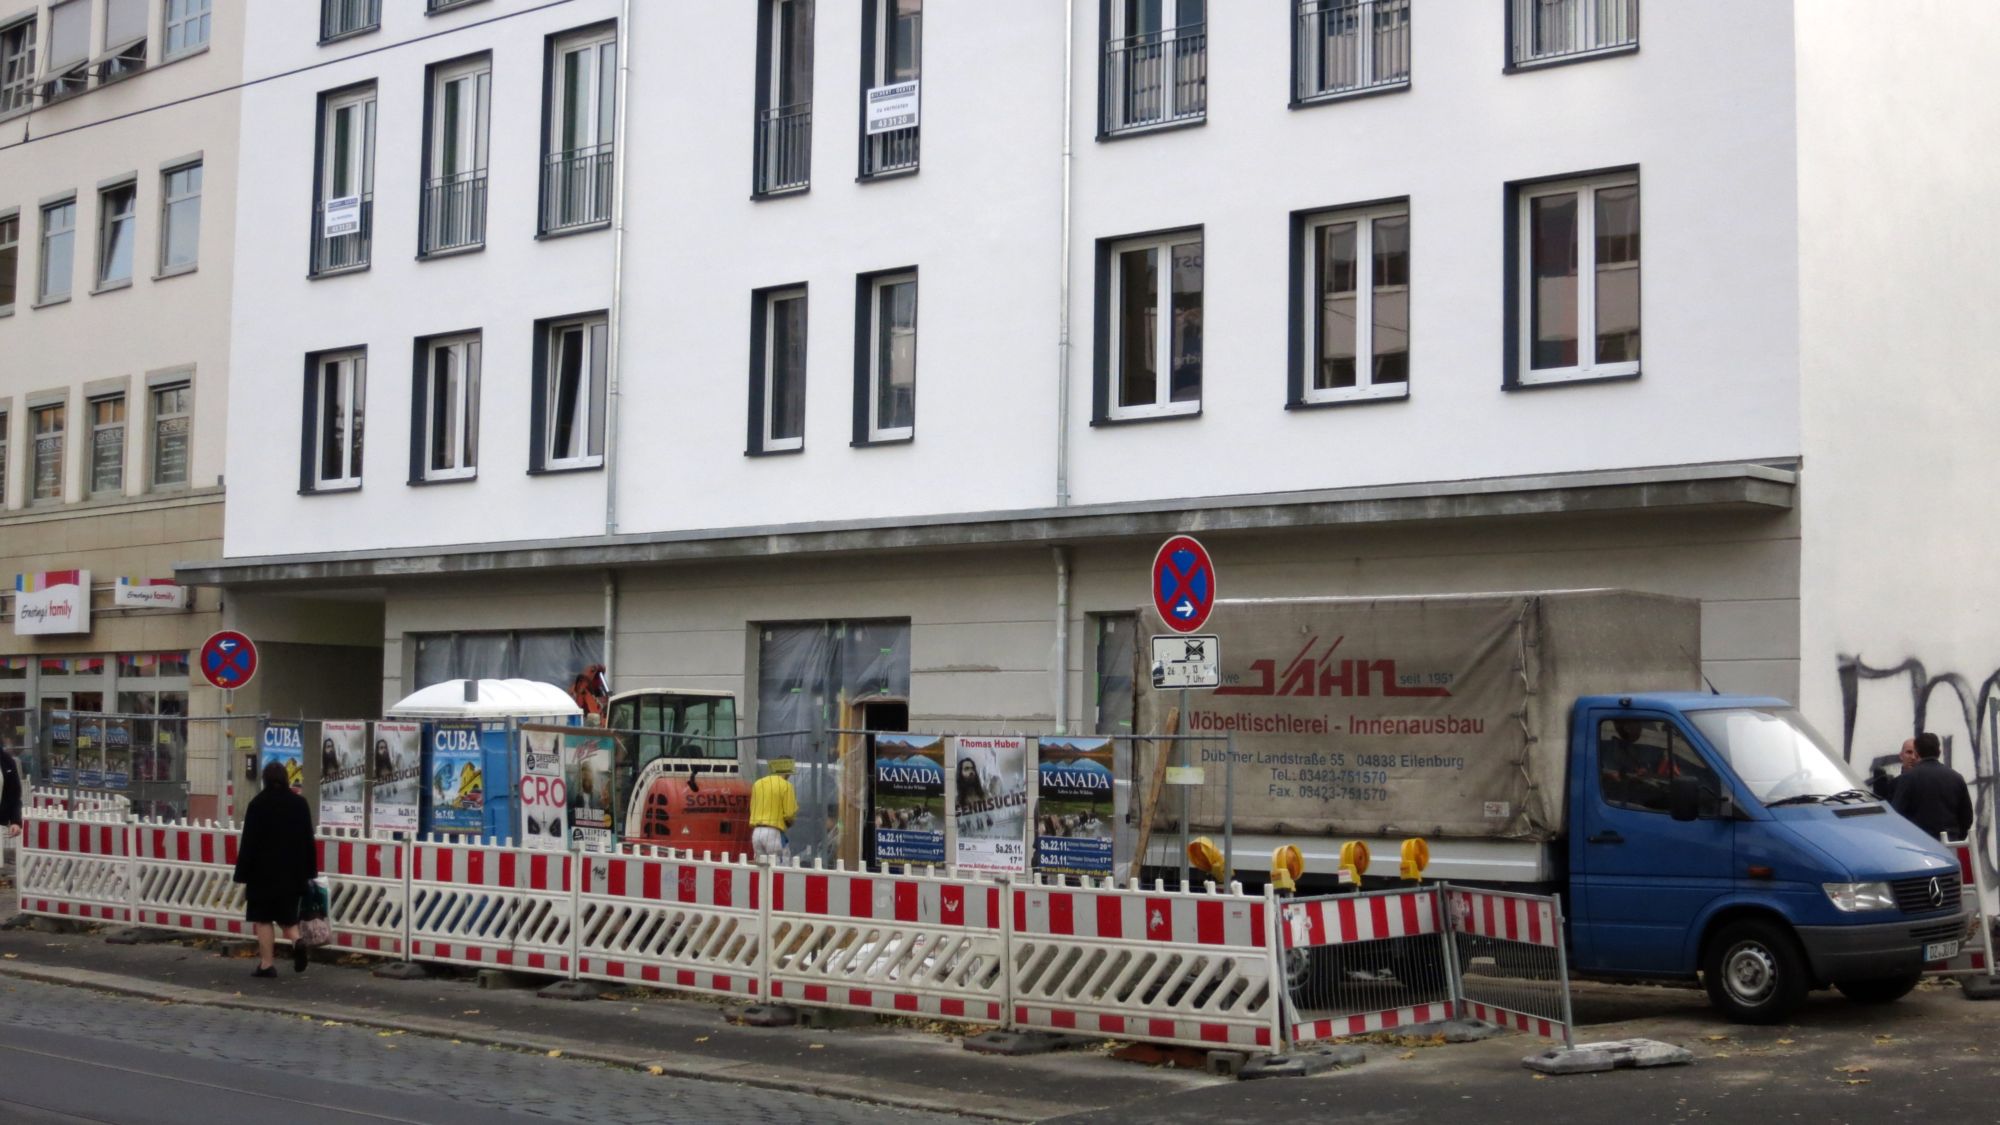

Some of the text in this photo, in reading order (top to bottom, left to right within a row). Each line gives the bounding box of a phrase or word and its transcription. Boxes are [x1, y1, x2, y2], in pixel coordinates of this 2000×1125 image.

[153, 591, 175, 602] family
[49, 600, 73, 619] family
[1193, 675, 1205, 683] Uhr
[1400, 673, 1420, 684] seit
[1188, 710, 1328, 734] Möbeltischlerei
[1349, 714, 1484, 735] Innenausbau
[264, 727, 301, 747] CUBA
[435, 730, 480, 750] CUBA
[960, 739, 1019, 748] Thomas Huber
[1201, 748, 1464, 770] Dübner Landstraße 55 04838 Eilenburg
[879, 767, 942, 785] KANADA
[1042, 771, 1110, 788] KANADA
[1299, 769, 1387, 785] 03423-751570
[519, 775, 567, 808] CRO
[1299, 785, 1387, 801] 03423-751570
[878, 832, 905, 843] Sa.22.11.
[1040, 840, 1070, 851] Sa.22.11.
[878, 846, 905, 857] So.23.11.
[995, 843, 1023, 854] Sa.29.11.
[1040, 854, 1070, 865] So.23.11.
